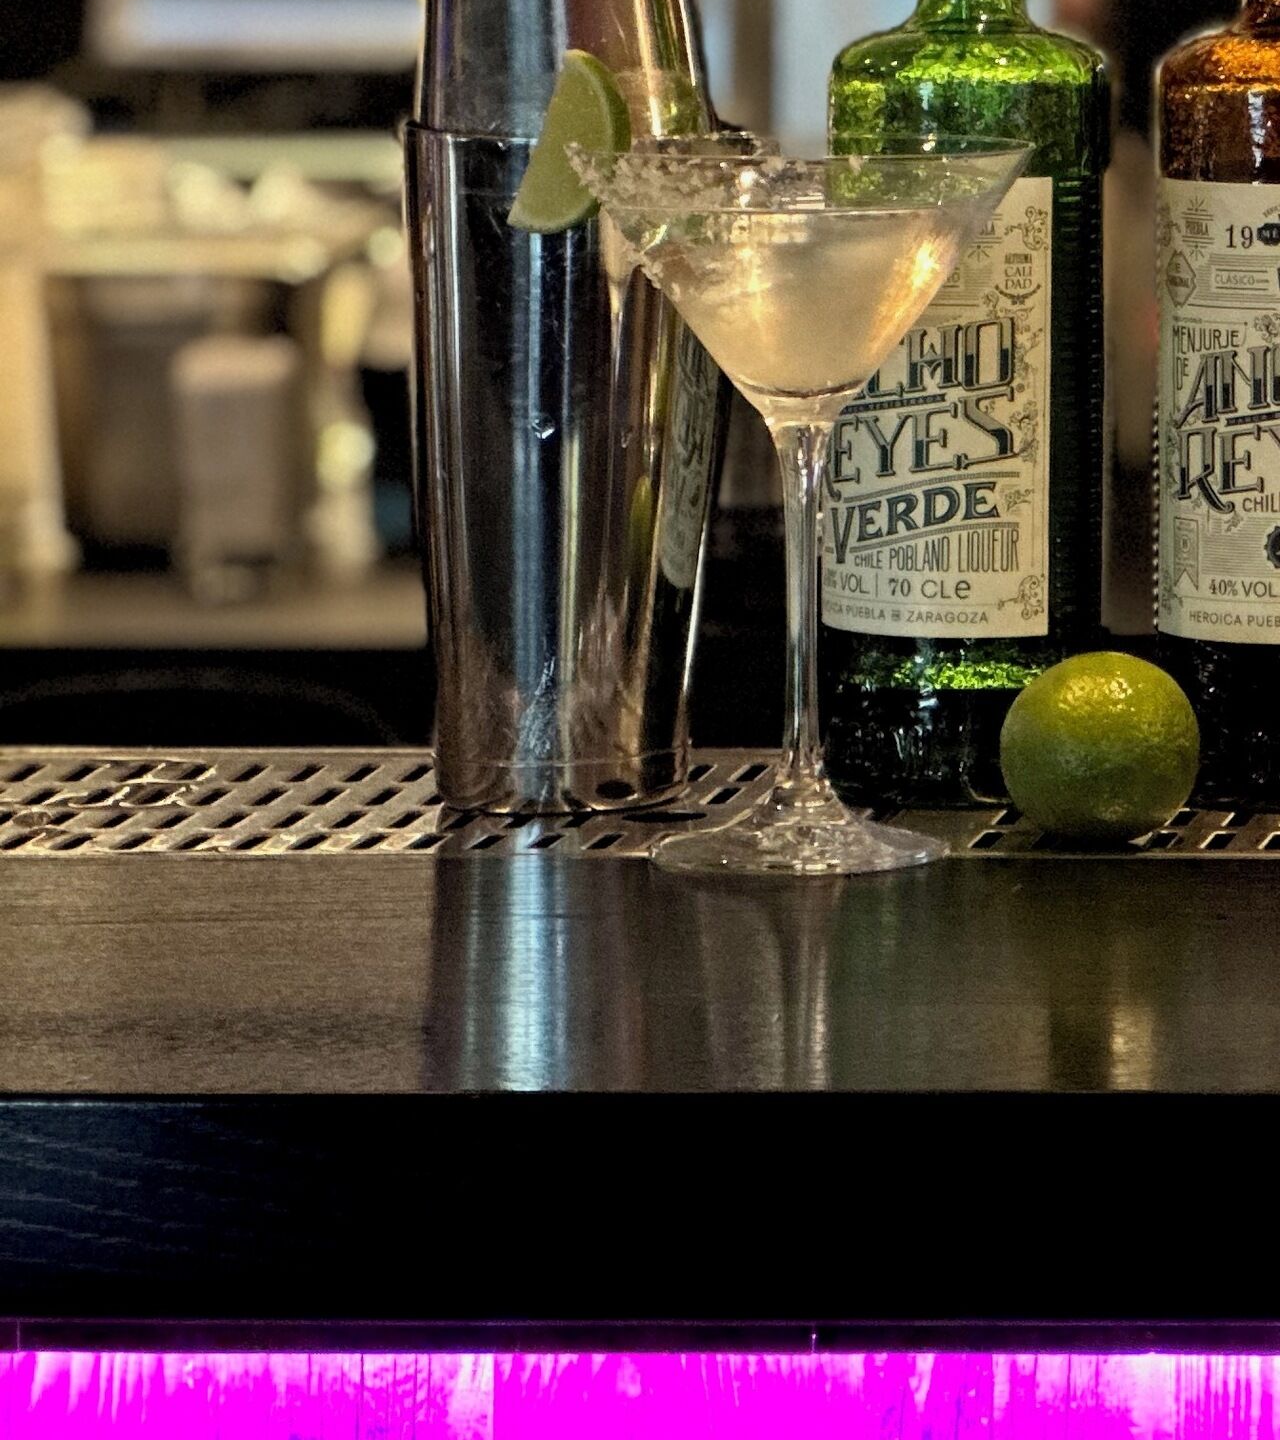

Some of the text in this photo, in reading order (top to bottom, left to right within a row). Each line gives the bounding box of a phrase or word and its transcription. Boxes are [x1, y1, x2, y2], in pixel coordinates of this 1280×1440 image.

[1225, 224, 1253, 249] 19
[1172, 325, 1241, 355] MENJURJE
[830, 481, 1000, 564] VERDE
[853, 527, 1020, 574] CHILE POBLANO LIQUEUR
[840, 572, 870, 595] VOL
[888, 577, 912, 597] 70
[1241, 580, 1280, 598] VOL
[905, 610, 989, 625] ZARAGOZA
[1188, 611, 1242, 626] HEROICA
